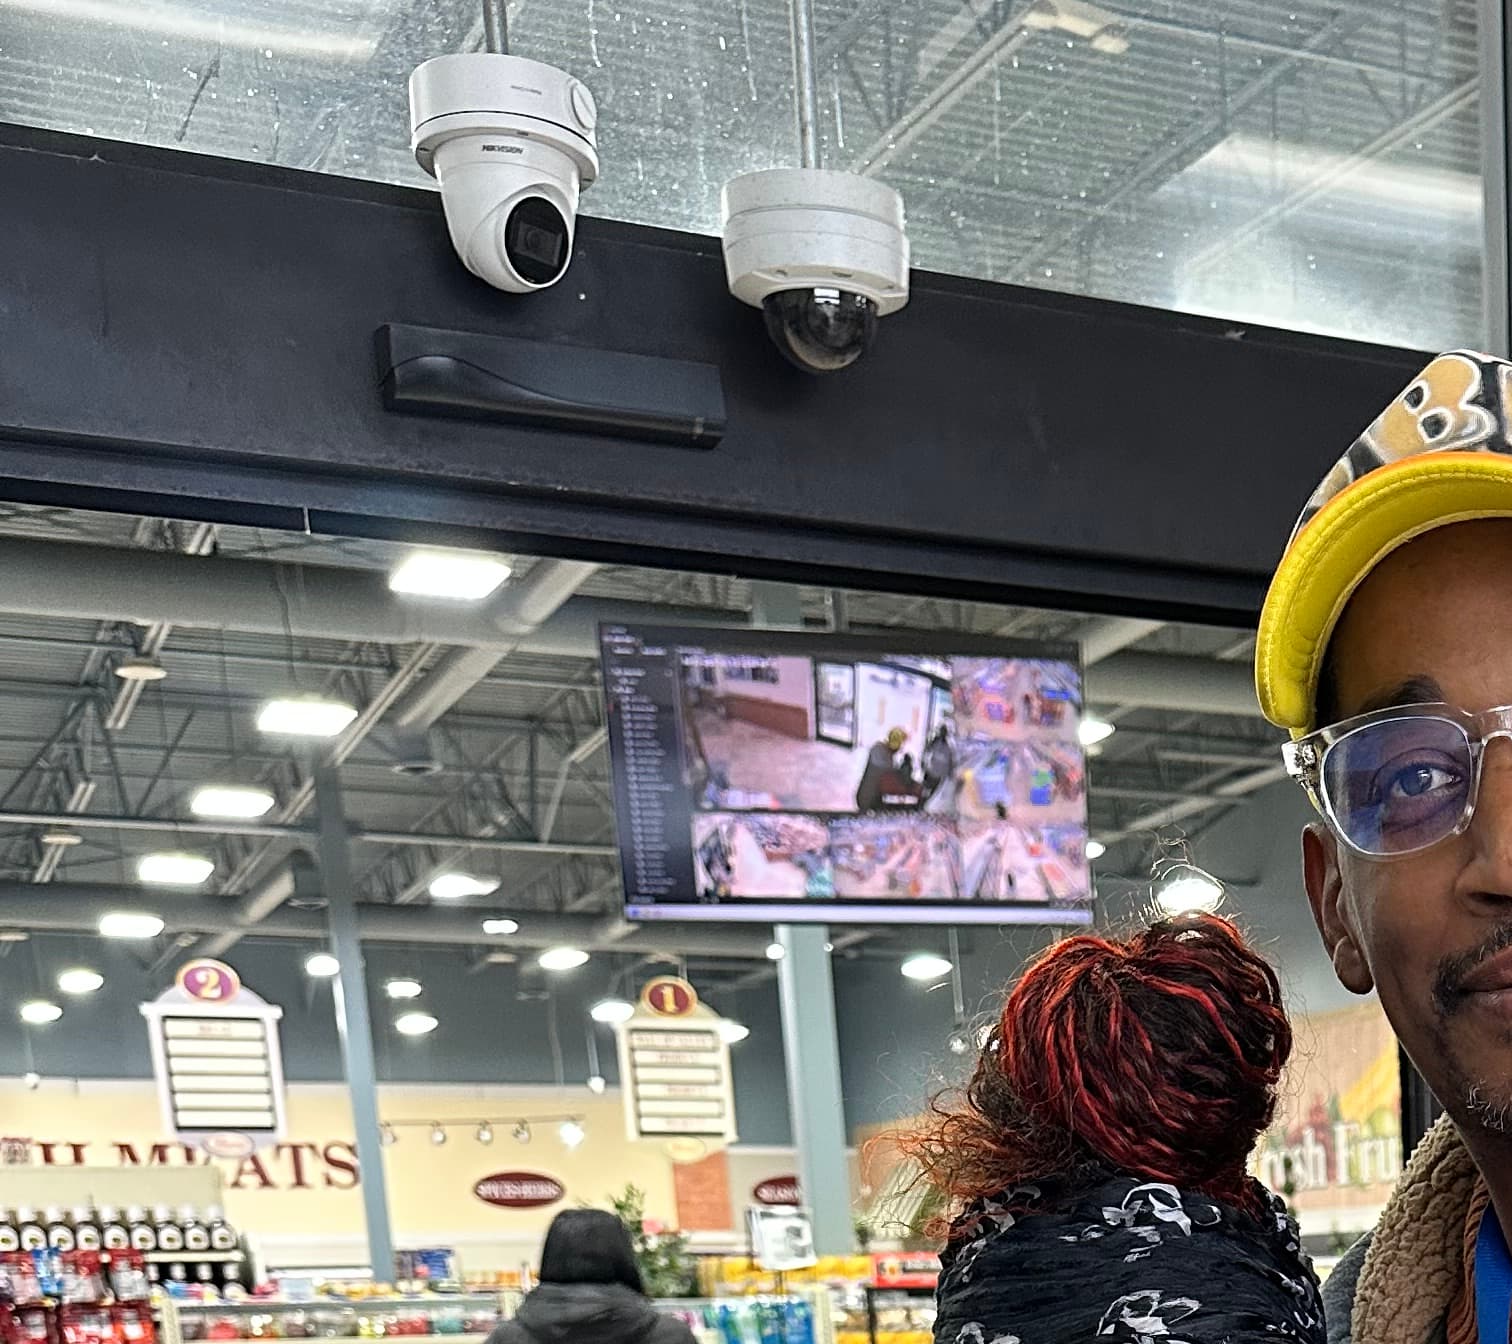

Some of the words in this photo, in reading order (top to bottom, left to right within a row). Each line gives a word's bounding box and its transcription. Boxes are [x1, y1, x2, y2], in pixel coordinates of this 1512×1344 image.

[195, 968, 222, 999] 2
[661, 986, 678, 1014] 1
[1334, 1122, 1402, 1184] Fru
